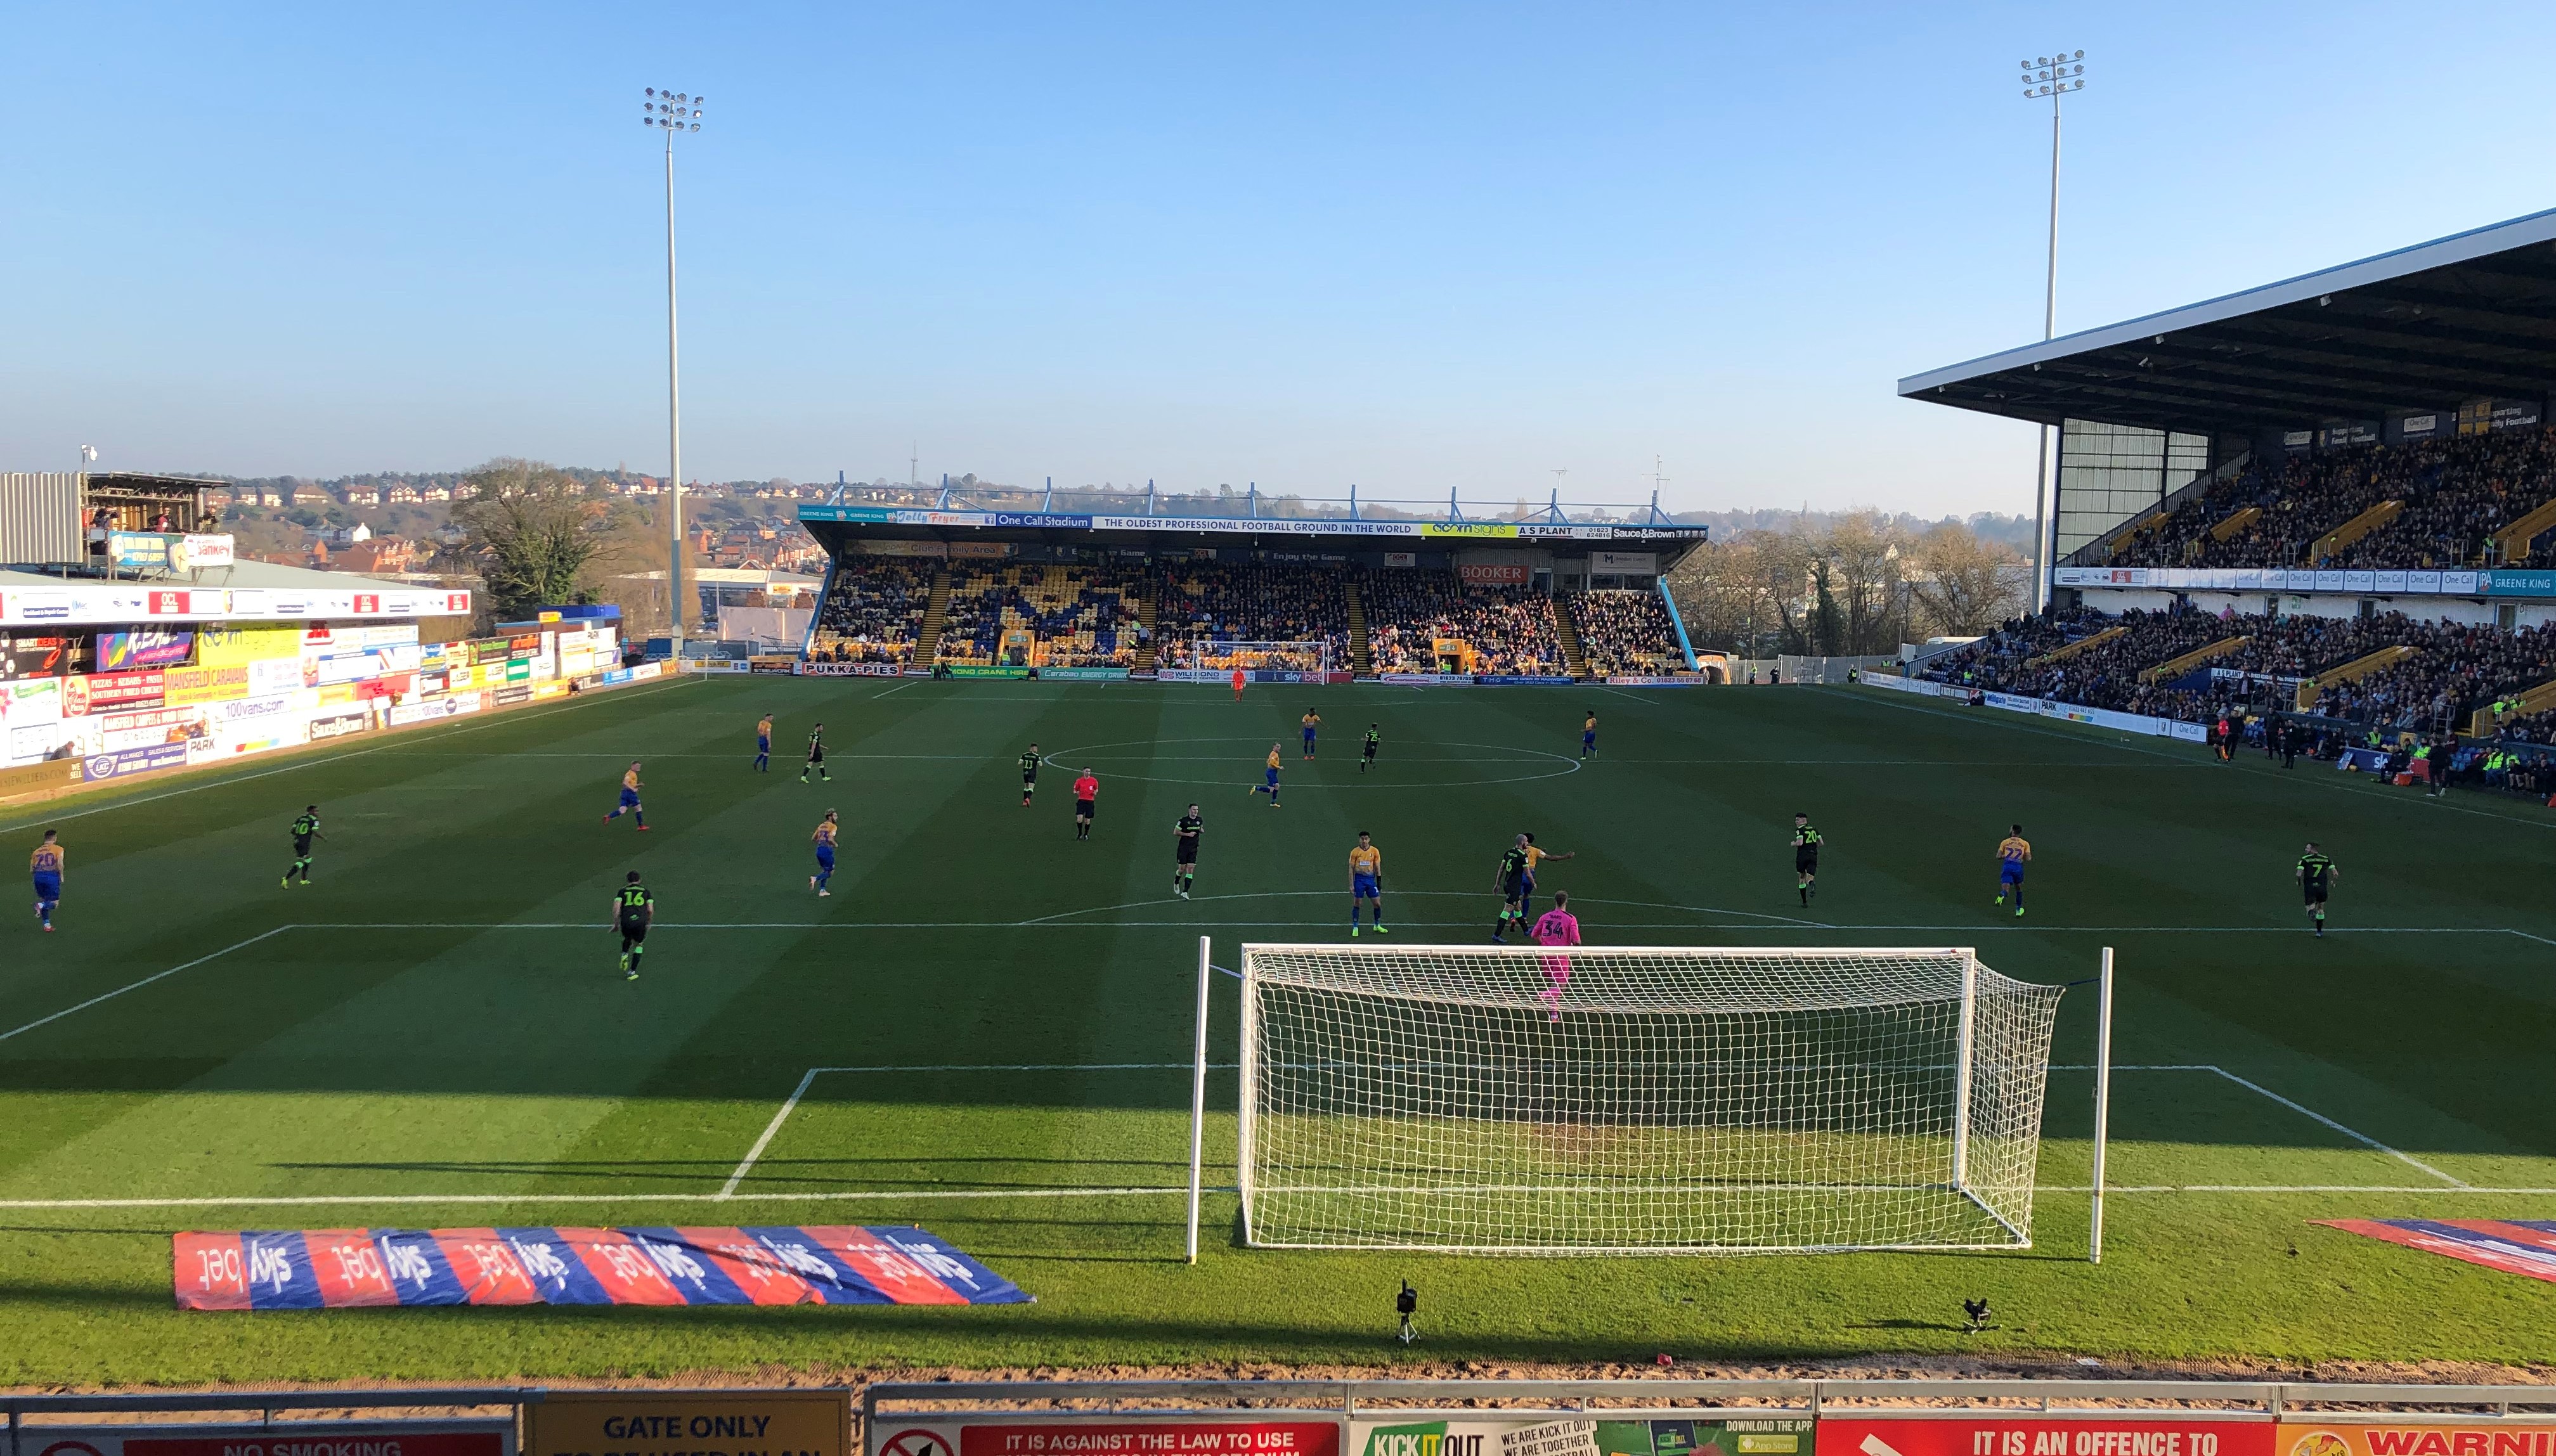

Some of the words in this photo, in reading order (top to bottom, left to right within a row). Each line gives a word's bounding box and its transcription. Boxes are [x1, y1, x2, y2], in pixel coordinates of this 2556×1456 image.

[2506, 415, 2536, 425] Football
[2351, 434, 2375, 442] Football
[898, 512, 927, 523] Jolly
[929, 512, 959, 523] Fryer
[999, 515, 1021, 526] One
[1023, 515, 1043, 526] Call
[1044, 516, 1088, 527] Stadium
[1105, 519, 1124, 527] THE
[1126, 519, 1163, 528] OLDEST
[1165, 520, 1238, 530] PROFESSIONAL
[1242, 522, 1292, 531] FOOTBALL
[1294, 523, 1339, 532] GROUND
[1341, 524, 1353, 532] IN
[1355, 524, 1373, 532] THE
[1376, 524, 1411, 534] WORLD
[1474, 525, 1506, 536] signs
[1613, 528, 1675, 539] Sauce&Brown
[1273, 553, 1299, 561] Enjoy
[1461, 567, 1522, 579] BOOKER
[2302, 574, 2312, 582] Call
[2330, 574, 2341, 582] Call
[2347, 574, 2359, 583] One
[2360, 574, 2371, 583] Call
[2378, 574, 2390, 583] One
[2391, 574, 2403, 583] Call
[2410, 574, 2423, 584] One
[2424, 574, 2437, 584] Call
[2445, 575, 2459, 584] One
[2460, 574, 2474, 584] Call
[2479, 573, 2492, 587] IPA
[2495, 578, 2527, 588] GREENE
[2529, 579, 2550, 588] KING
[161, 593, 178, 605] OCL
[805, 664, 898, 676] PUKKA-PIES
[1045, 669, 1079, 678] Carabao
[91, 679, 112, 688] PIZZAS
[166, 669, 209, 690] MANSFIELD
[211, 667, 248, 686] CARAVANS
[1285, 671, 1301, 683] sky
[1305, 671, 1322, 681] bet
[225, 700, 284, 718] 100vans.com
[2041, 701, 2056, 711] PARK
[2179, 724, 2189, 733] One
[2189, 725, 2199, 735] Call
[190, 738, 215, 753] PARK
[71, 763, 81, 771] WE
[70, 771, 82, 780] SELL
[1805, 830, 1817, 844] 20
[2005, 847, 2022, 860] 22
[35, 853, 56, 869] 20
[1506, 859, 1512, 872] 6
[2312, 864, 2323, 877] 7
[624, 891, 645, 906] 16
[1542, 920, 1564, 939] 34
[251, 1236, 292, 1294] sky
[332, 1245, 390, 1291] bet
[381, 1236, 432, 1291] sky
[198, 1248, 245, 1293] bet
[603, 1415, 682, 1439] GATE
[689, 1415, 772, 1438] ONLY
[1726, 1420, 1775, 1432] DOWNLOAD
[1777, 1421, 1793, 1432] THE
[1794, 1421, 1813, 1433] APP
[1501, 1434, 1517, 1446] WE
[1519, 1429, 1538, 1443] ARE
[1539, 1424, 1560, 1440] KICK
[1562, 1422, 1571, 1436] IT
[1006, 1433, 1022, 1450] IT
[1028, 1433, 1046, 1450] IS
[1049, 1434, 1131, 1450] AGAINST
[1138, 1433, 1174, 1449] THE
[1181, 1433, 1221, 1449] LAW
[1226, 1433, 1252, 1448] TO
[1257, 1432, 1294, 1448] USE
[1375, 1434, 1422, 1456] KICK
[1423, 1434, 1440, 1456] IT
[1445, 1435, 1484, 1456] OUT
[1521, 1443, 1540, 1456] ARE
[1541, 1434, 1590, 1452] TOGETHER
[1755, 1442, 1771, 1452] App
[1772, 1441, 1794, 1450] Store
[1974, 1431, 1997, 1456] IT
[2002, 1431, 2026, 1456] IS
[2033, 1431, 2068, 1456] AN
[2075, 1431, 2182, 1456] OFFENCE
[2189, 1433, 2218, 1456] TO
[2365, 1431, 2556, 1456] WARNI
[224, 1445, 264, 1456] NO
[276, 1441, 401, 1456] SMOKING
